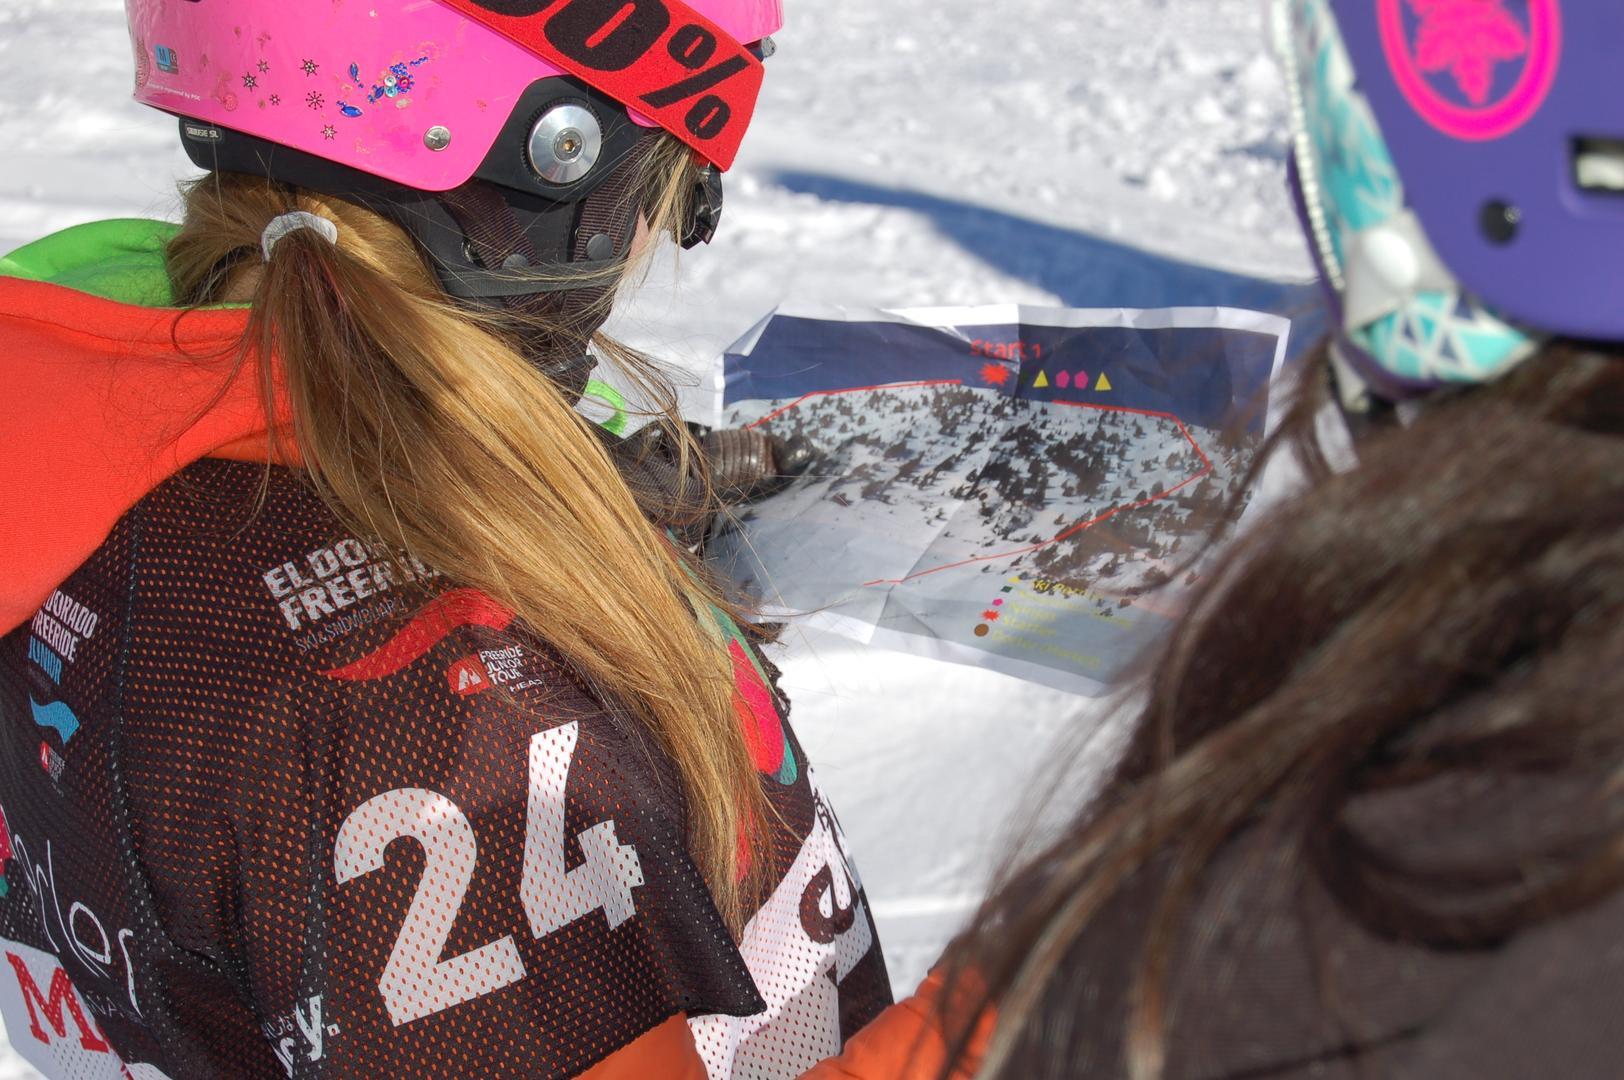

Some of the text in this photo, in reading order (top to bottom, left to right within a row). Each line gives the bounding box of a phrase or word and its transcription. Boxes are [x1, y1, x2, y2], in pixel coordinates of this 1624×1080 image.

[469, 0, 750, 140] 0%
[279, 557, 440, 630] FREER
[28, 635, 62, 685] JUNIOR
[480, 645, 523, 663] FREERIDE
[489, 669, 524, 685] TOUR
[334, 721, 645, 1028] 24
